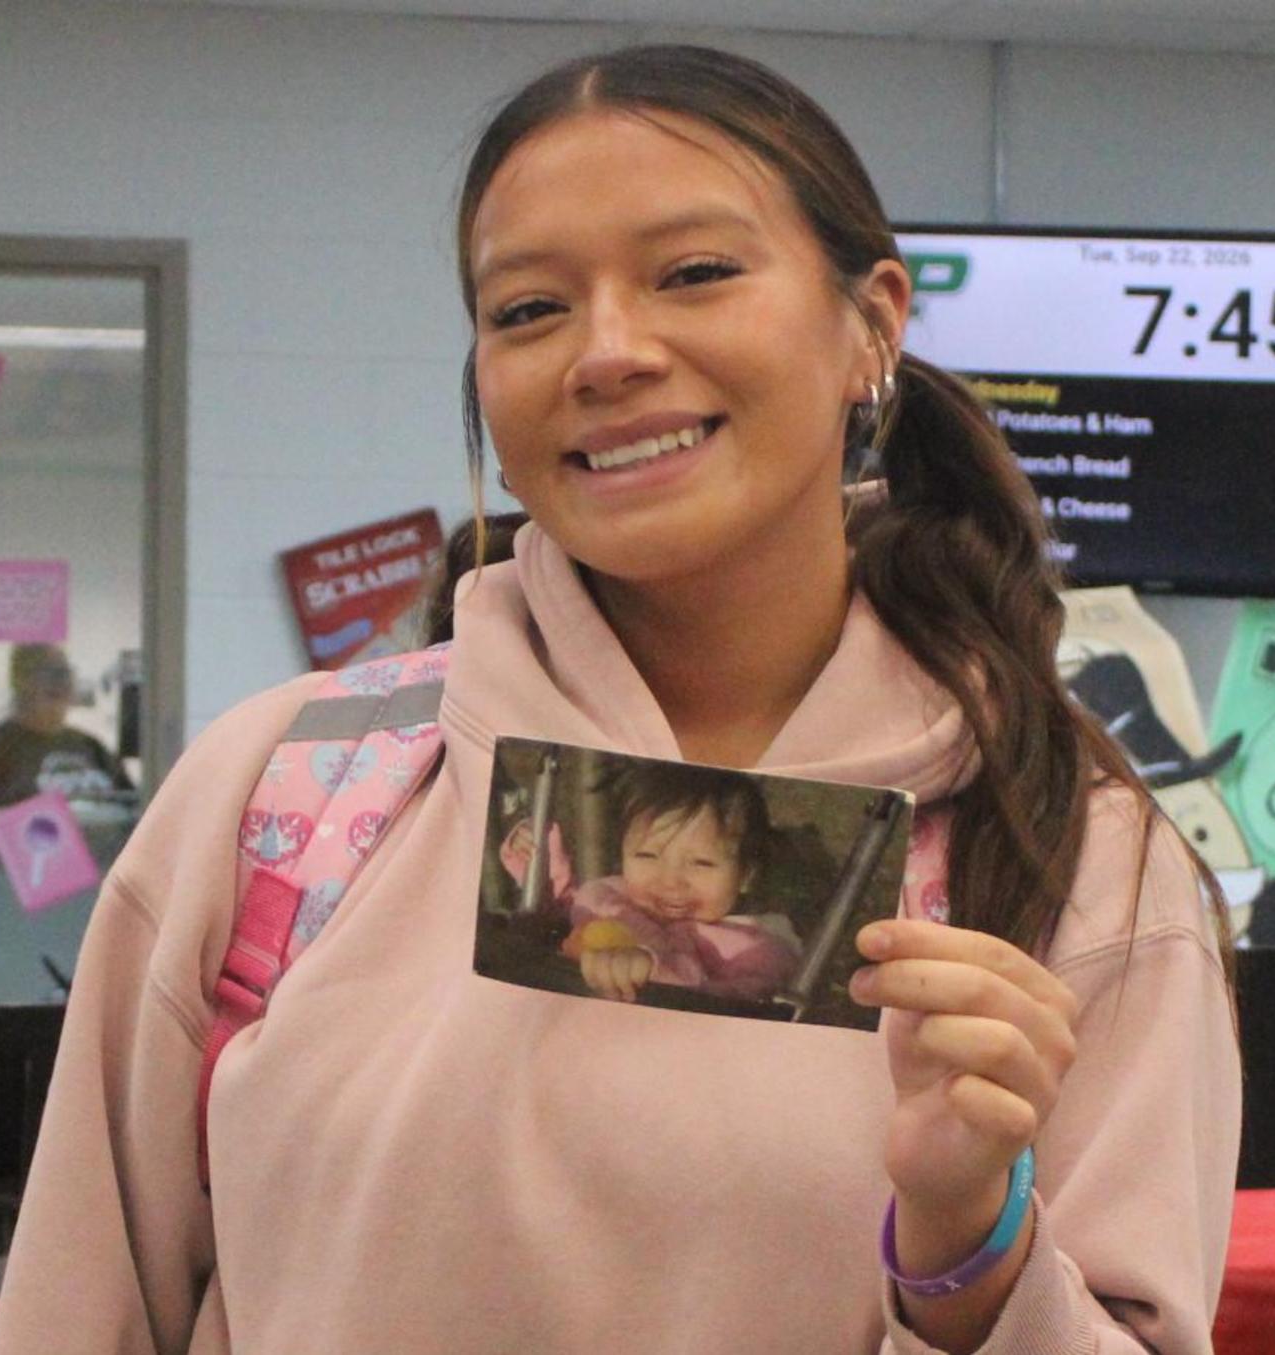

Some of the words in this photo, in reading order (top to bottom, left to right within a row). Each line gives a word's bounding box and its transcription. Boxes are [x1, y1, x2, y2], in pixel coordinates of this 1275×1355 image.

[1080, 244, 1119, 265] Tue,
[1126, 245, 1161, 267] Sep
[1169, 246, 1197, 267] 22,
[997, 408, 1082, 433] Potatoes
[1085, 411, 1101, 434] &
[1104, 412, 1154, 436] Ham
[1072, 454, 1132, 480] Bread
[1040, 495, 1056, 519] &
[1057, 496, 1133, 522] Cheese
